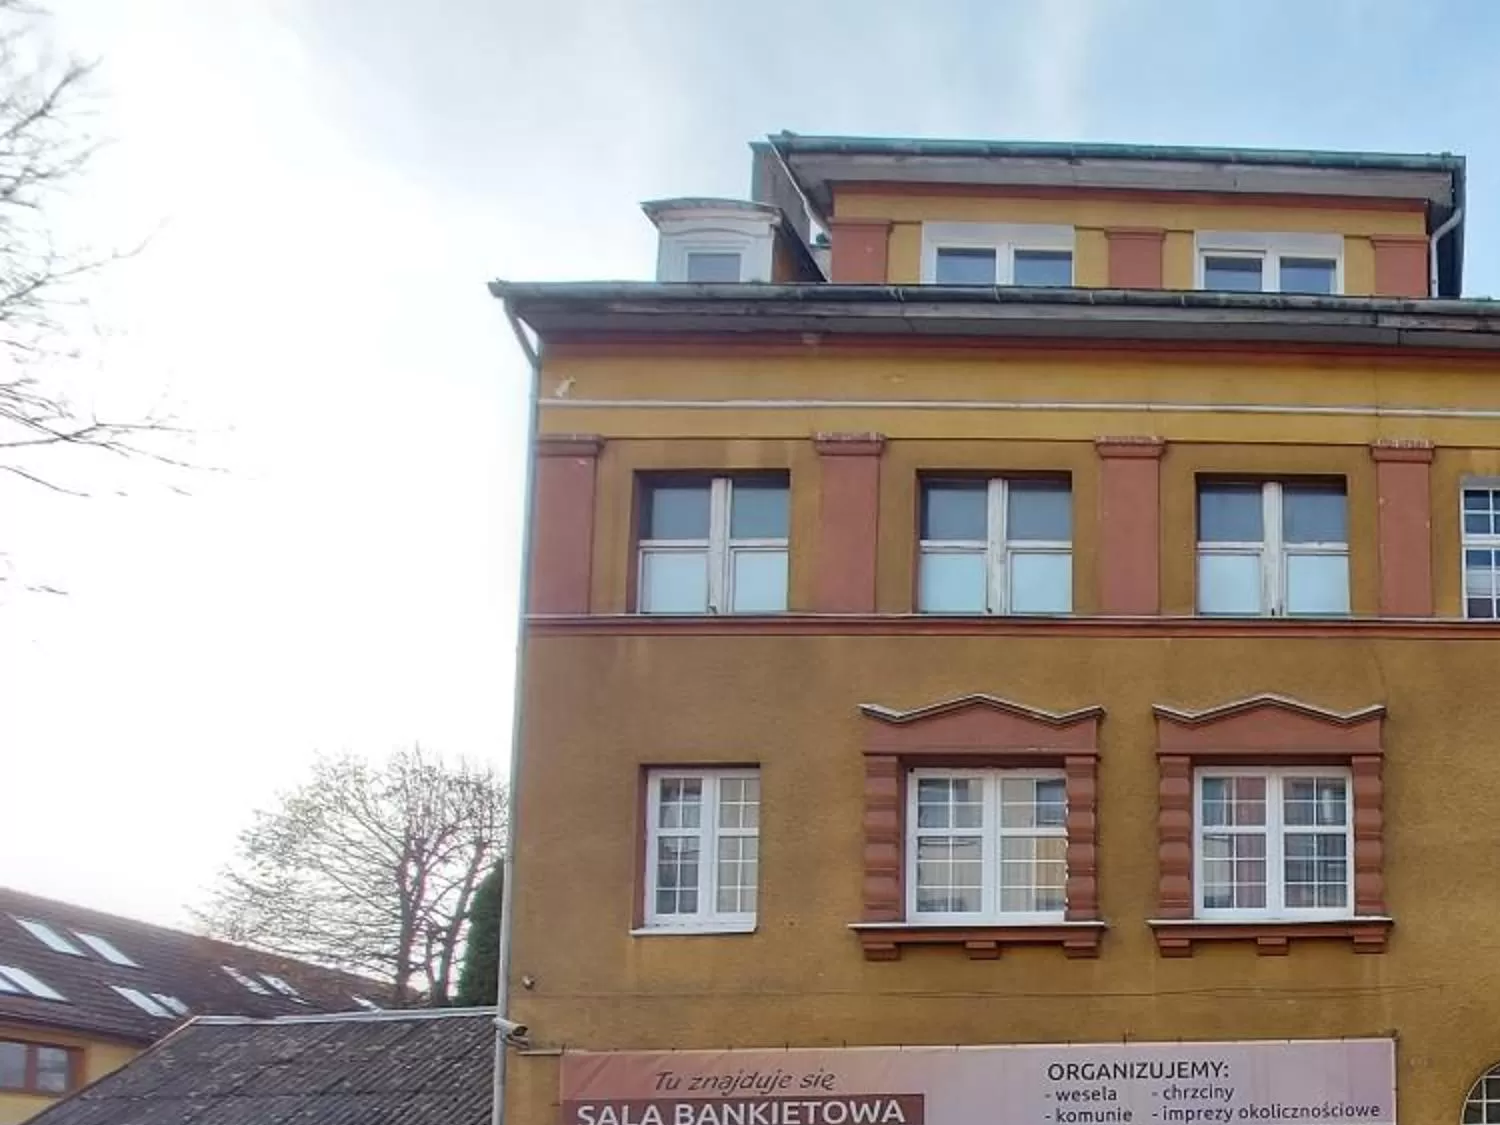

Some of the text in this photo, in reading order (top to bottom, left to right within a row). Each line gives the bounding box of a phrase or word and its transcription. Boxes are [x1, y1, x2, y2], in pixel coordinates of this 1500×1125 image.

[1047, 1061, 1230, 1081] ORGANIZUJEMY:
[654, 1068, 837, 1096] Tu znajduje się
[1055, 1086, 1118, 1102] wesela
[1162, 1083, 1235, 1102] chrzciny
[1055, 1107, 1133, 1123] komunie
[1162, 1101, 1381, 1124] imprezy okolicznościowe
